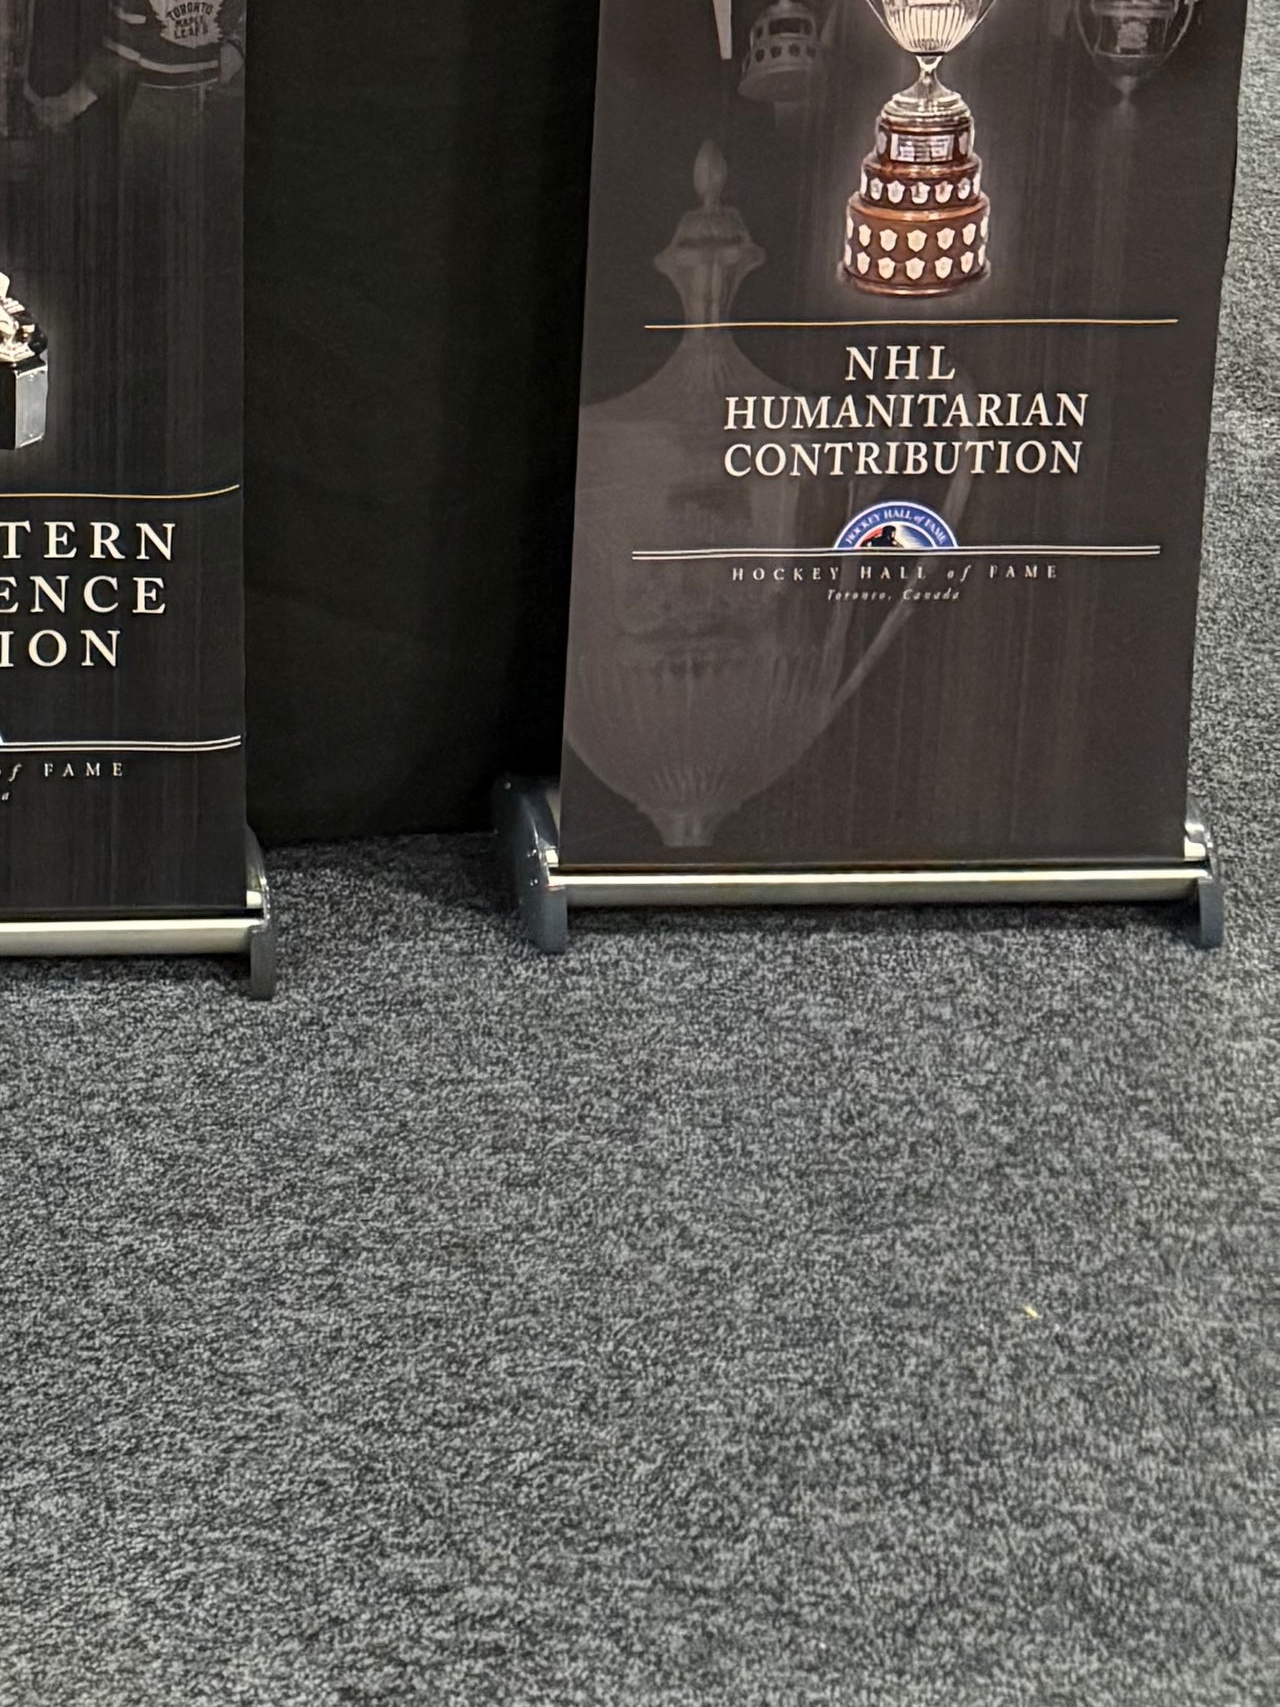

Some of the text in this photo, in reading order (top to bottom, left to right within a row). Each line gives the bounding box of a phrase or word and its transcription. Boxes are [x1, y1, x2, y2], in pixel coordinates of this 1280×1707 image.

[845, 345, 956, 381] NHL
[723, 392, 1089, 430] HUMANITARIAN
[724, 440, 1083, 477] CONTRIBUTION
[732, 564, 1058, 582] HOCKEY HALL of FAME
[44, 762, 123, 778] FAME
